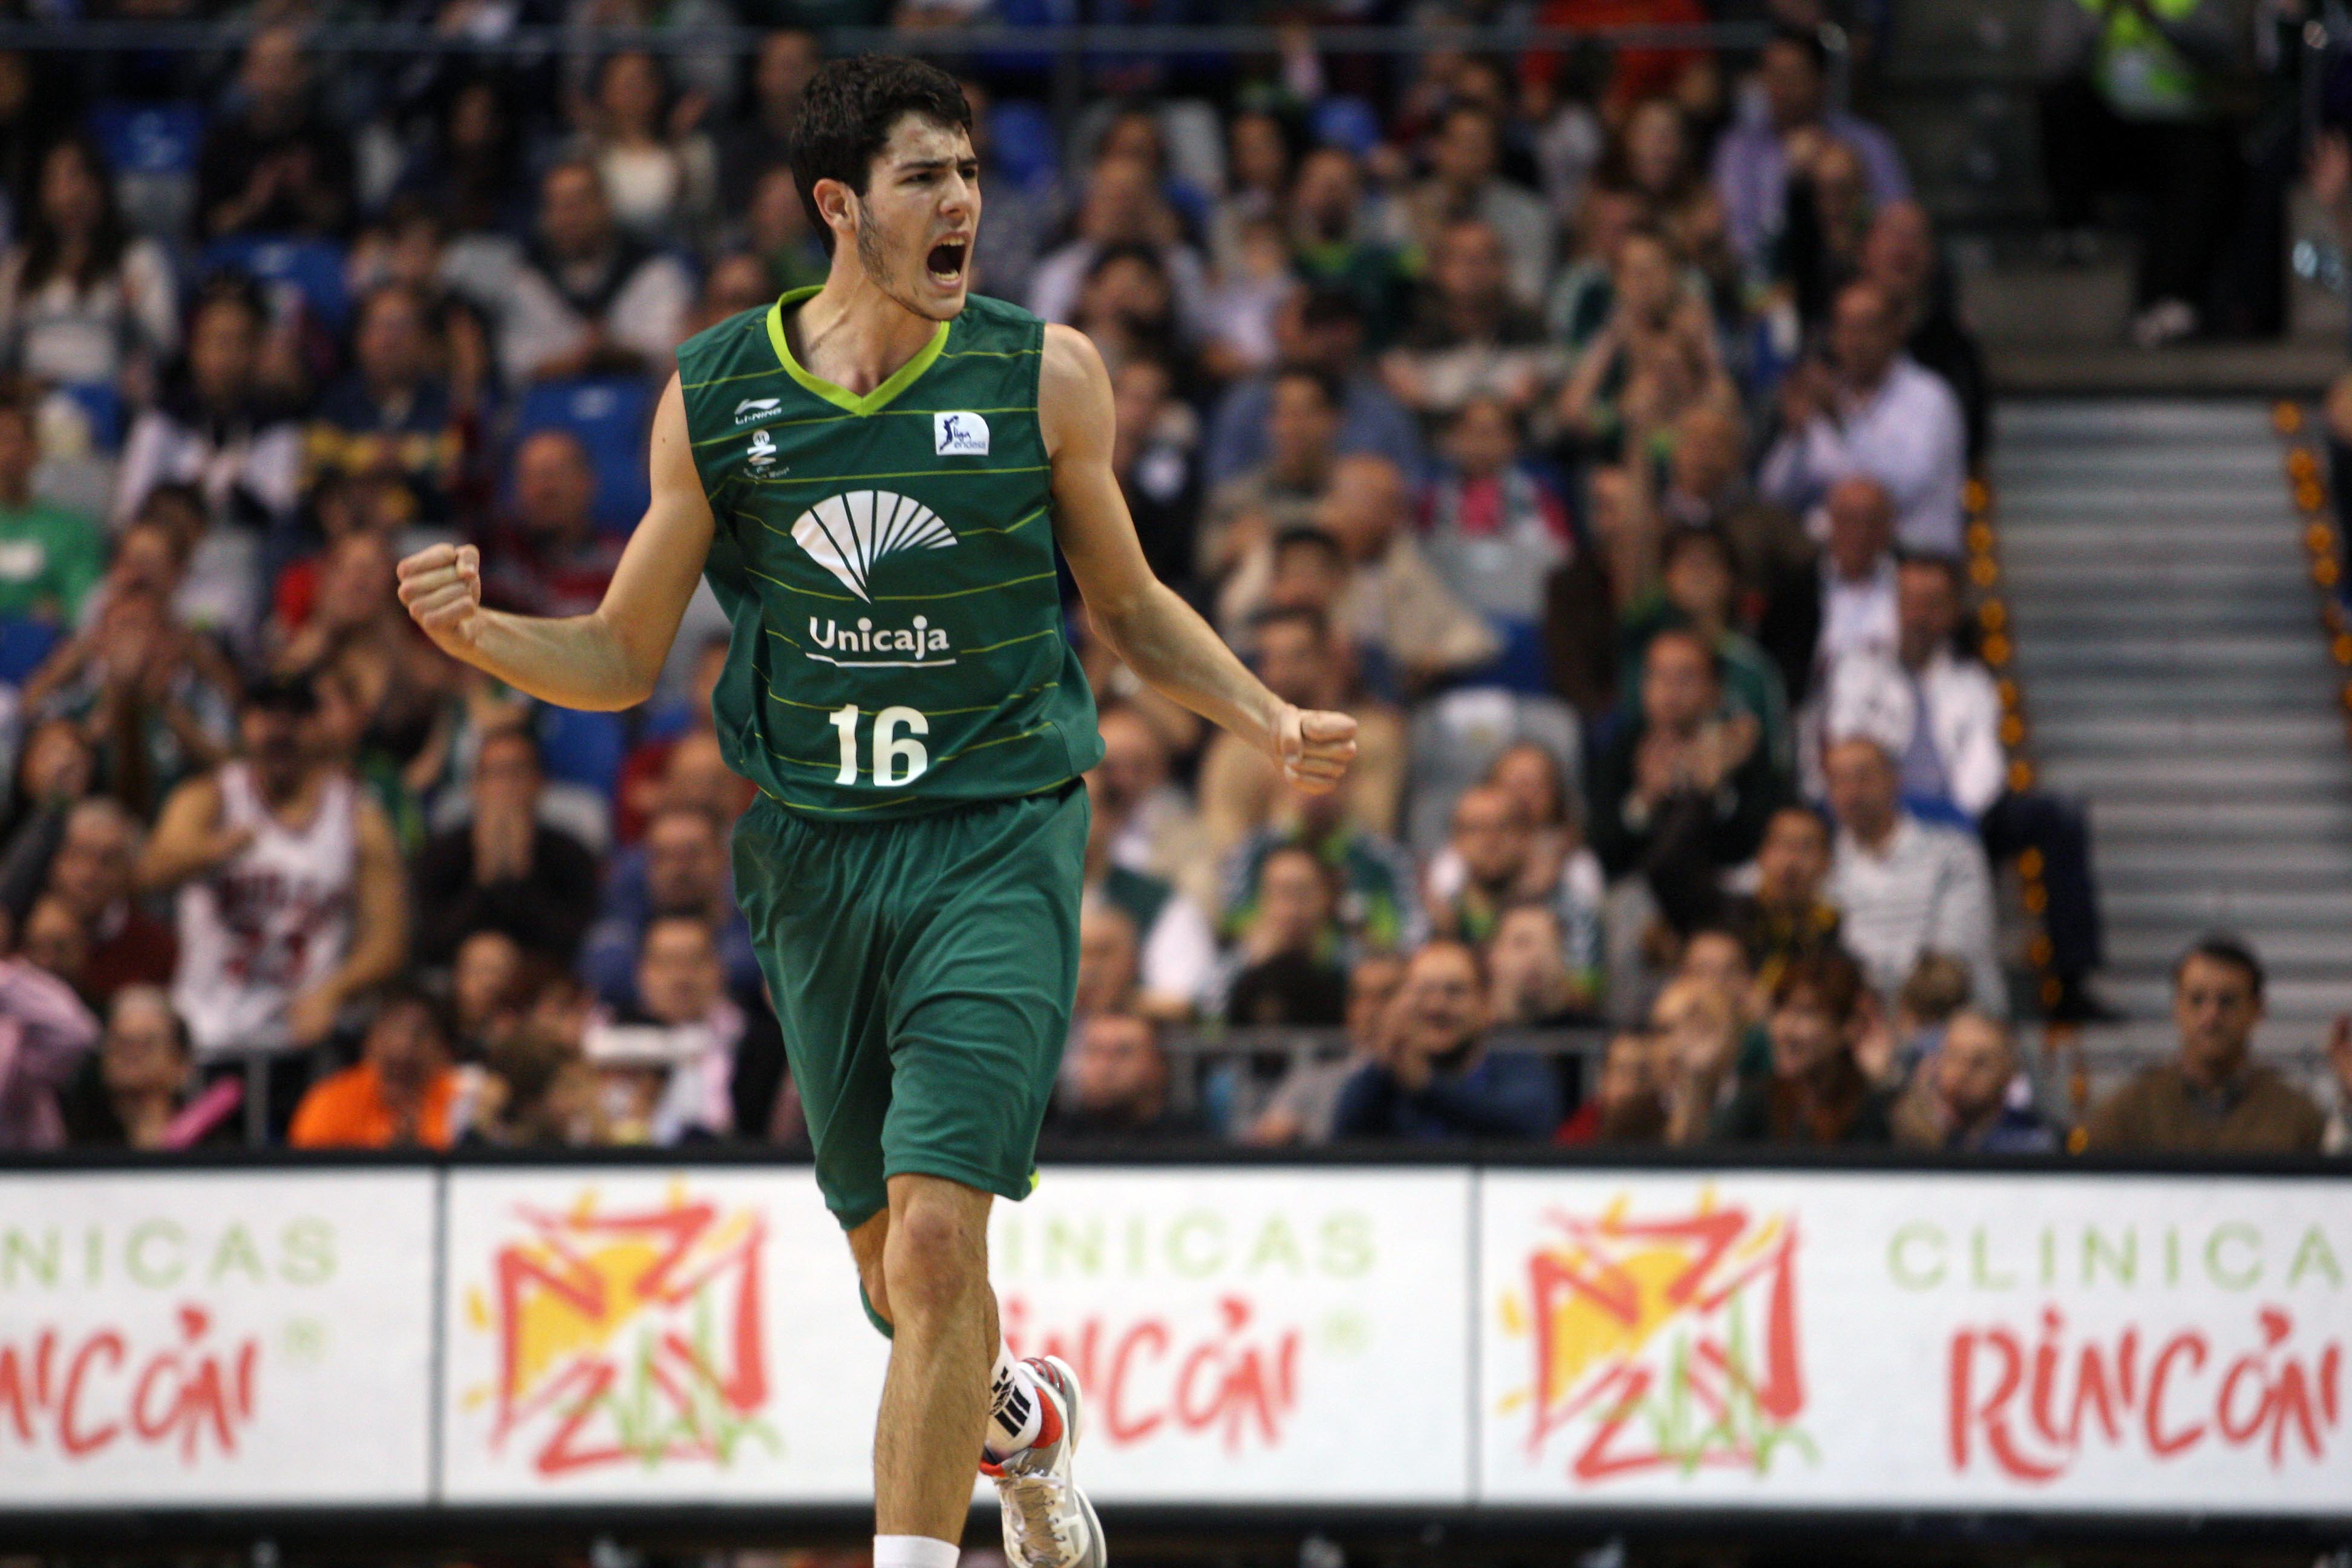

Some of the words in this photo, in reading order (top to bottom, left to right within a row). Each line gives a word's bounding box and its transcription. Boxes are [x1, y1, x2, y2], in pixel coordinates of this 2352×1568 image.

[809, 615, 950, 660] Unicaja
[829, 704, 929, 786] 16
[1886, 1218, 2345, 1291] CLINICA
